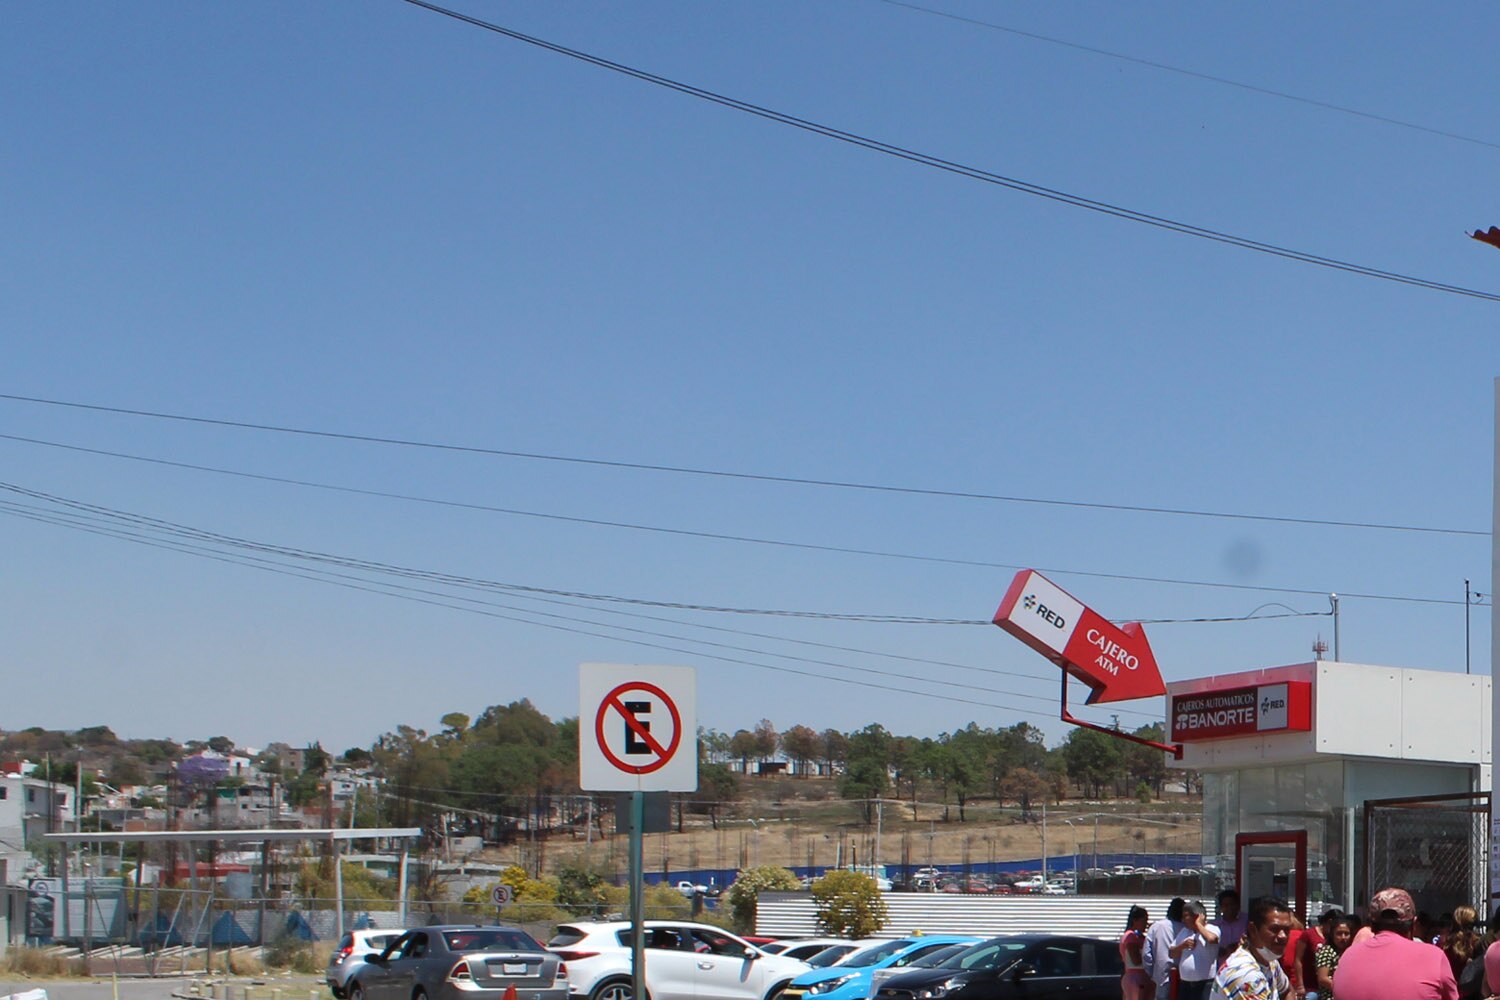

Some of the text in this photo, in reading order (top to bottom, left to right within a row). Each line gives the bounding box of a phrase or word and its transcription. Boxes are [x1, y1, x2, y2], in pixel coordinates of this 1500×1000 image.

[1036, 604, 1066, 629] RED
[1086, 628, 1139, 670] CAJERO
[1094, 655, 1119, 676] ATM
[1177, 693, 1254, 713] CAJEROS AUTOMATICOS
[624, 701, 652, 755] E
[1188, 707, 1254, 729] BANORTE
